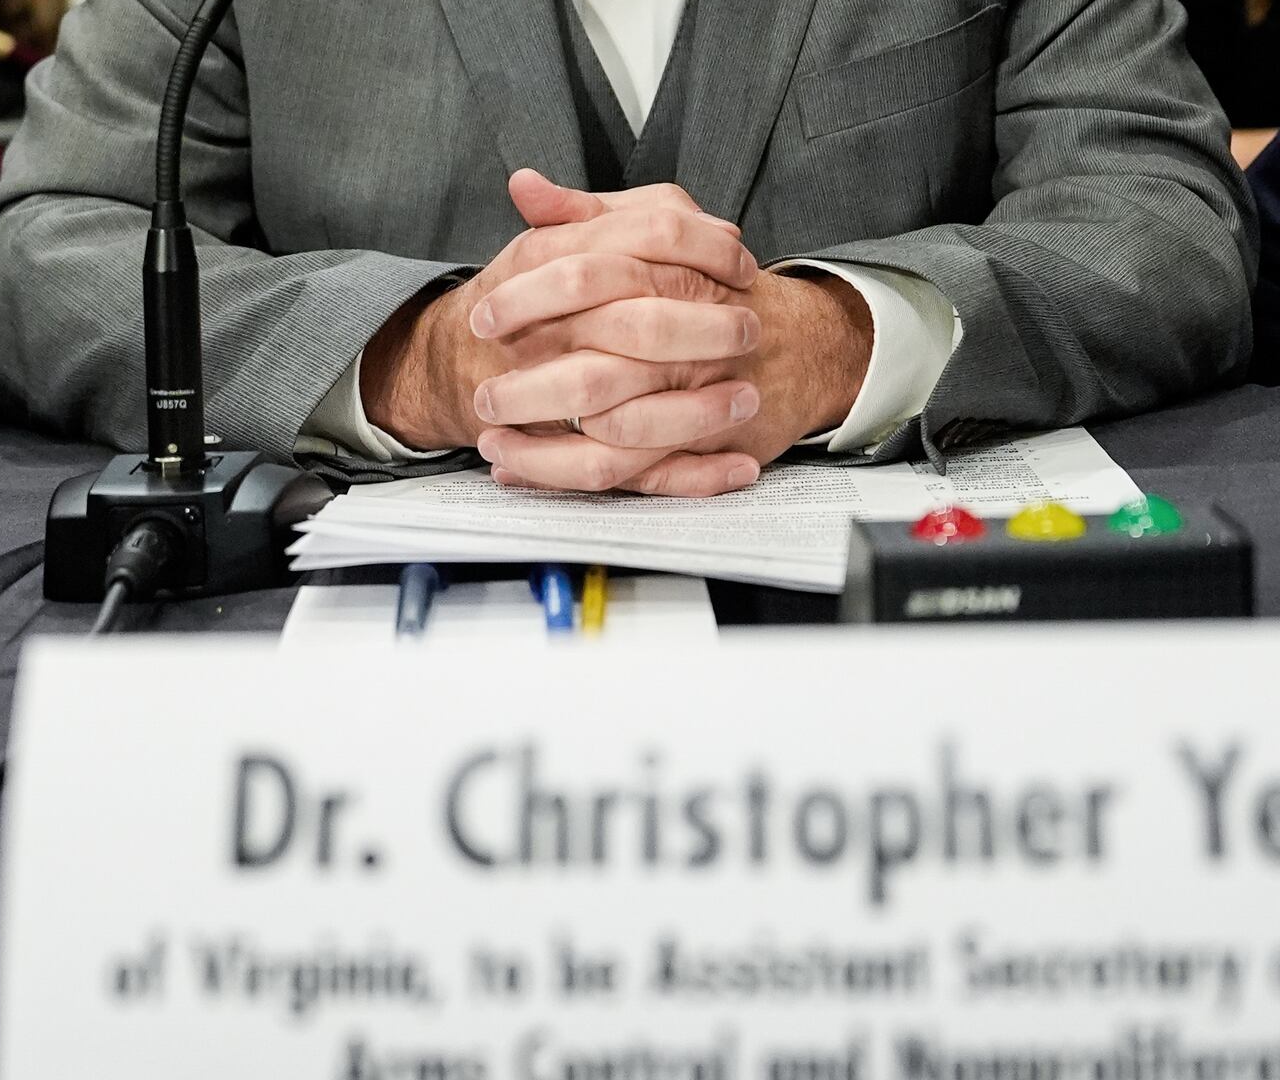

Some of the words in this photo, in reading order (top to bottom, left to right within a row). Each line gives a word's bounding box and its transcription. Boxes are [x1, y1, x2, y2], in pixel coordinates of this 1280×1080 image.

[229, 750, 381, 873] Dr.
[441, 744, 1114, 908] Christopher
[111, 930, 166, 999] of
[194, 936, 436, 1020] Virginia,
[471, 948, 523, 996] to
[556, 936, 618, 997] be
[651, 936, 926, 996] Assistant
[959, 932, 1243, 1010] Secretary
[517, 1030, 738, 1080] Control
[761, 1035, 868, 1080] and
